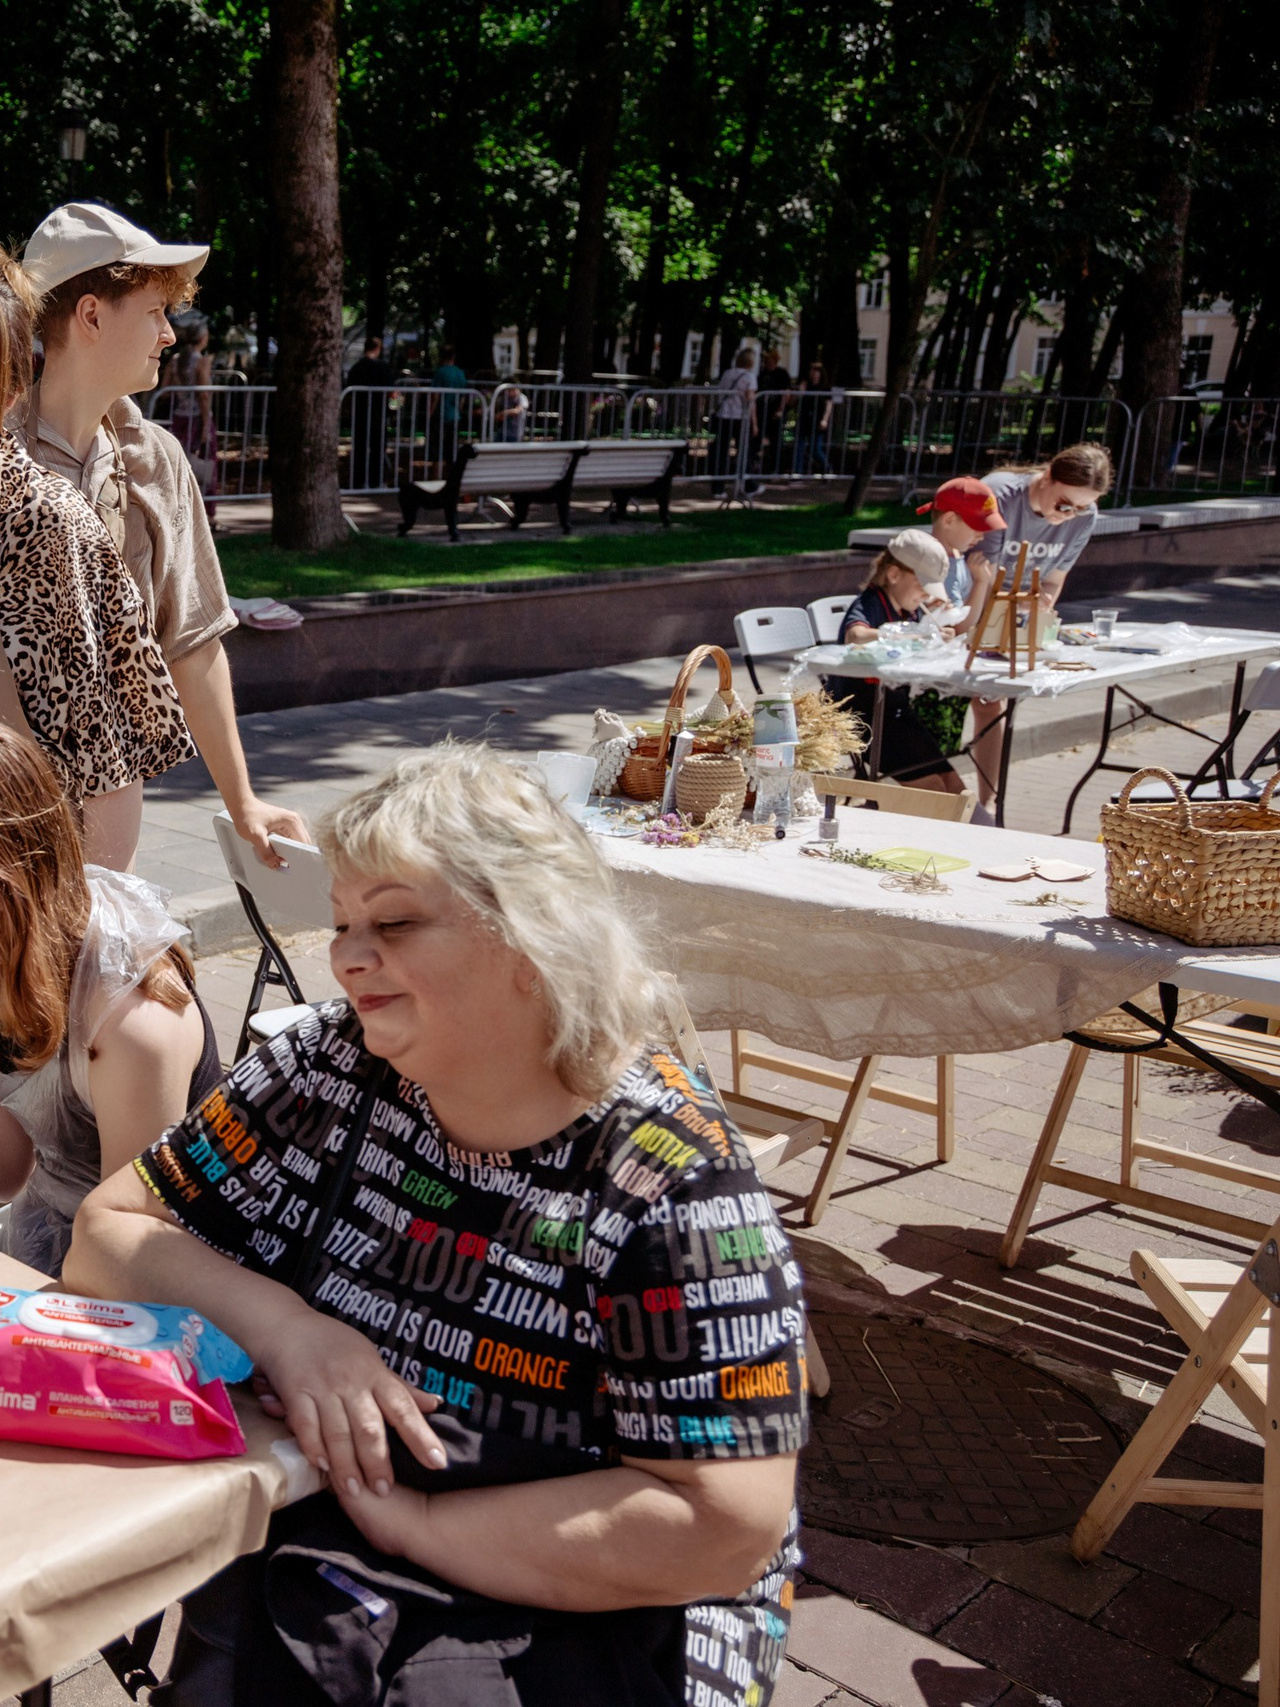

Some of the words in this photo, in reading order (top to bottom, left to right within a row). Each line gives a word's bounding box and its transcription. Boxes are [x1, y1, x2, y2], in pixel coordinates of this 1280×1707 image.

[186, 1133, 228, 1183] BLUE
[401, 1169, 459, 1210] GREEN
[407, 1217, 439, 1245] RED
[675, 1194, 740, 1233] PANGO
[716, 1226, 766, 1262] GREEN
[61, 1297, 126, 1316] Laima
[643, 1286, 681, 1313] RED
[684, 1281, 705, 1309] IS
[709, 1272, 768, 1307] WHERO
[41, 1309, 127, 1329] ANTIBACTERIAL
[472, 1277, 569, 1338] WHITE
[315, 1271, 397, 1331] KARAKA
[396, 1308, 422, 1343] IS
[423, 1318, 474, 1364] OUR
[473, 1337, 570, 1391] ORANGE
[697, 1308, 784, 1362] WHITE
[21, 1335, 142, 1366] АНТИБАКТЕРИАЛЬНЫЕ
[422, 1366, 476, 1410] BLUE
[721, 1361, 792, 1401] ORANGE
[172, 1405, 192, 1417] 120
[652, 1414, 675, 1444] IS
[678, 1415, 737, 1446] BLUE
